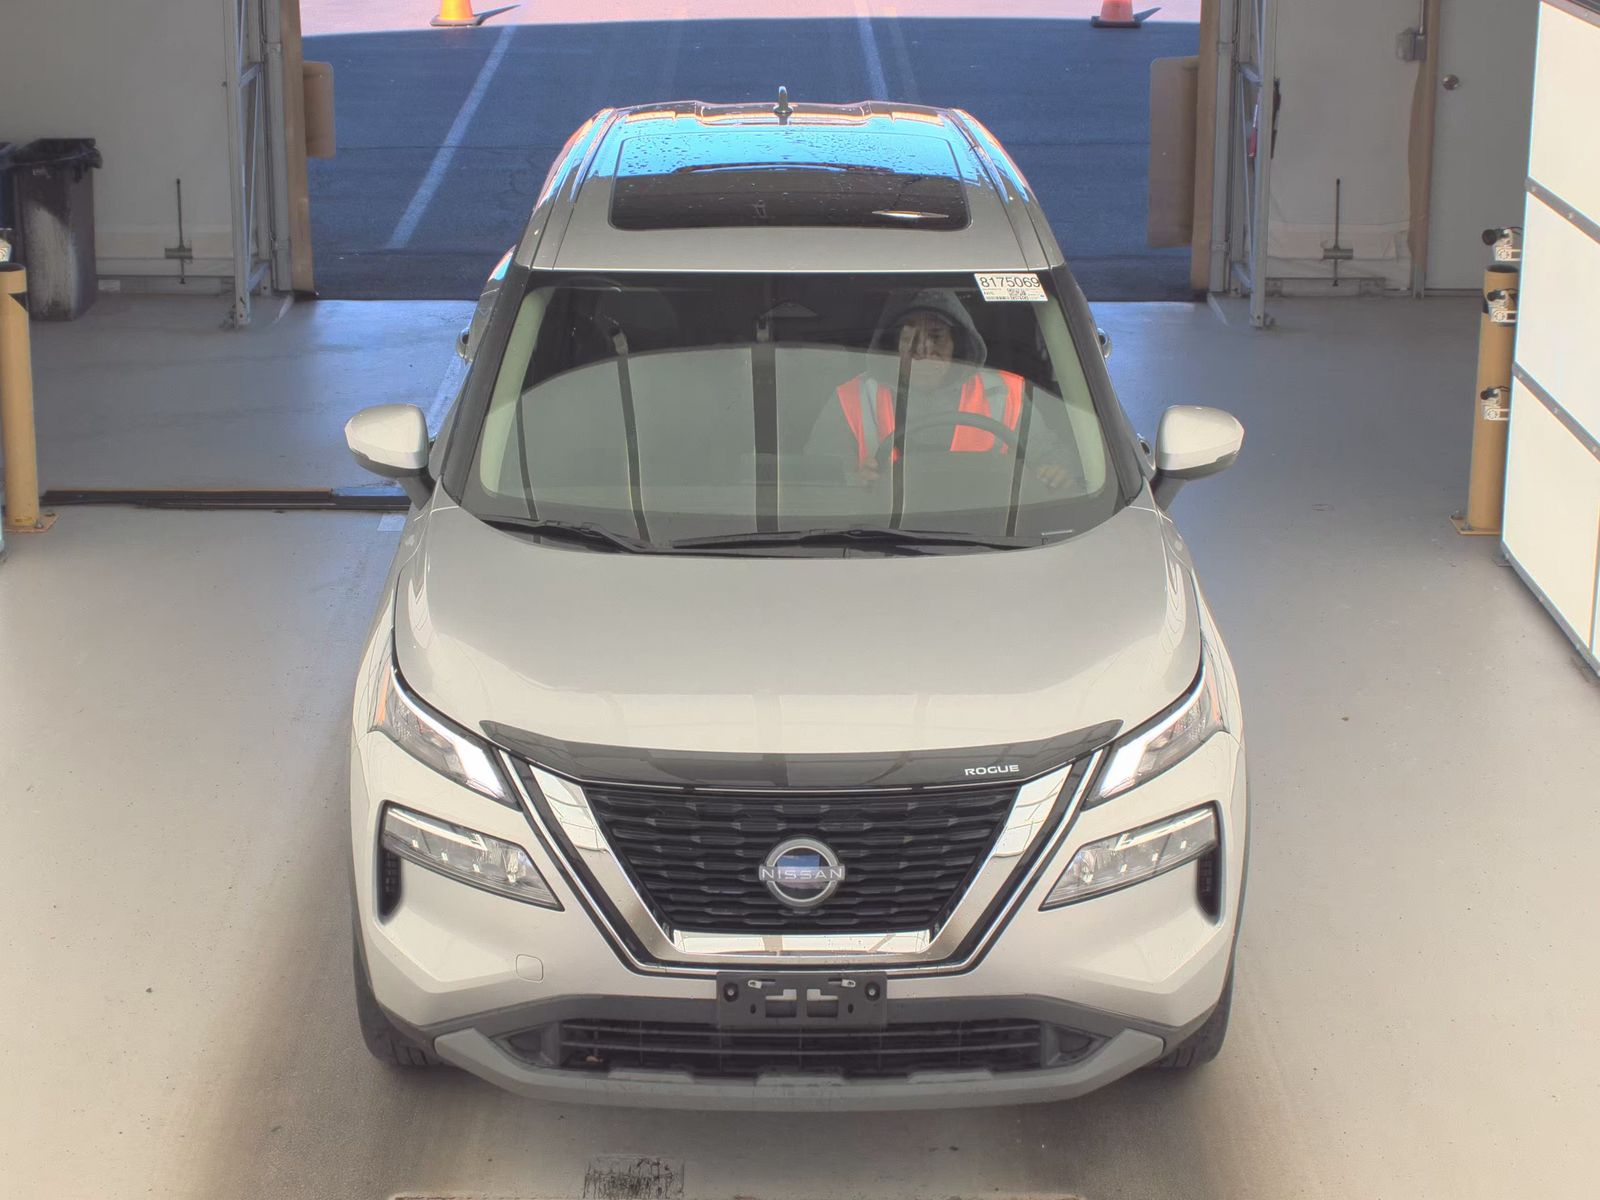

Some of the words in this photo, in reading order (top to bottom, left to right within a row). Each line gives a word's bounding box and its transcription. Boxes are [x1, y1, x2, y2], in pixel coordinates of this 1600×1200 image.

[979, 276, 1041, 288] 8175069
[964, 764, 1020, 776] ROGUE
[761, 868, 843, 880] NISSAN
